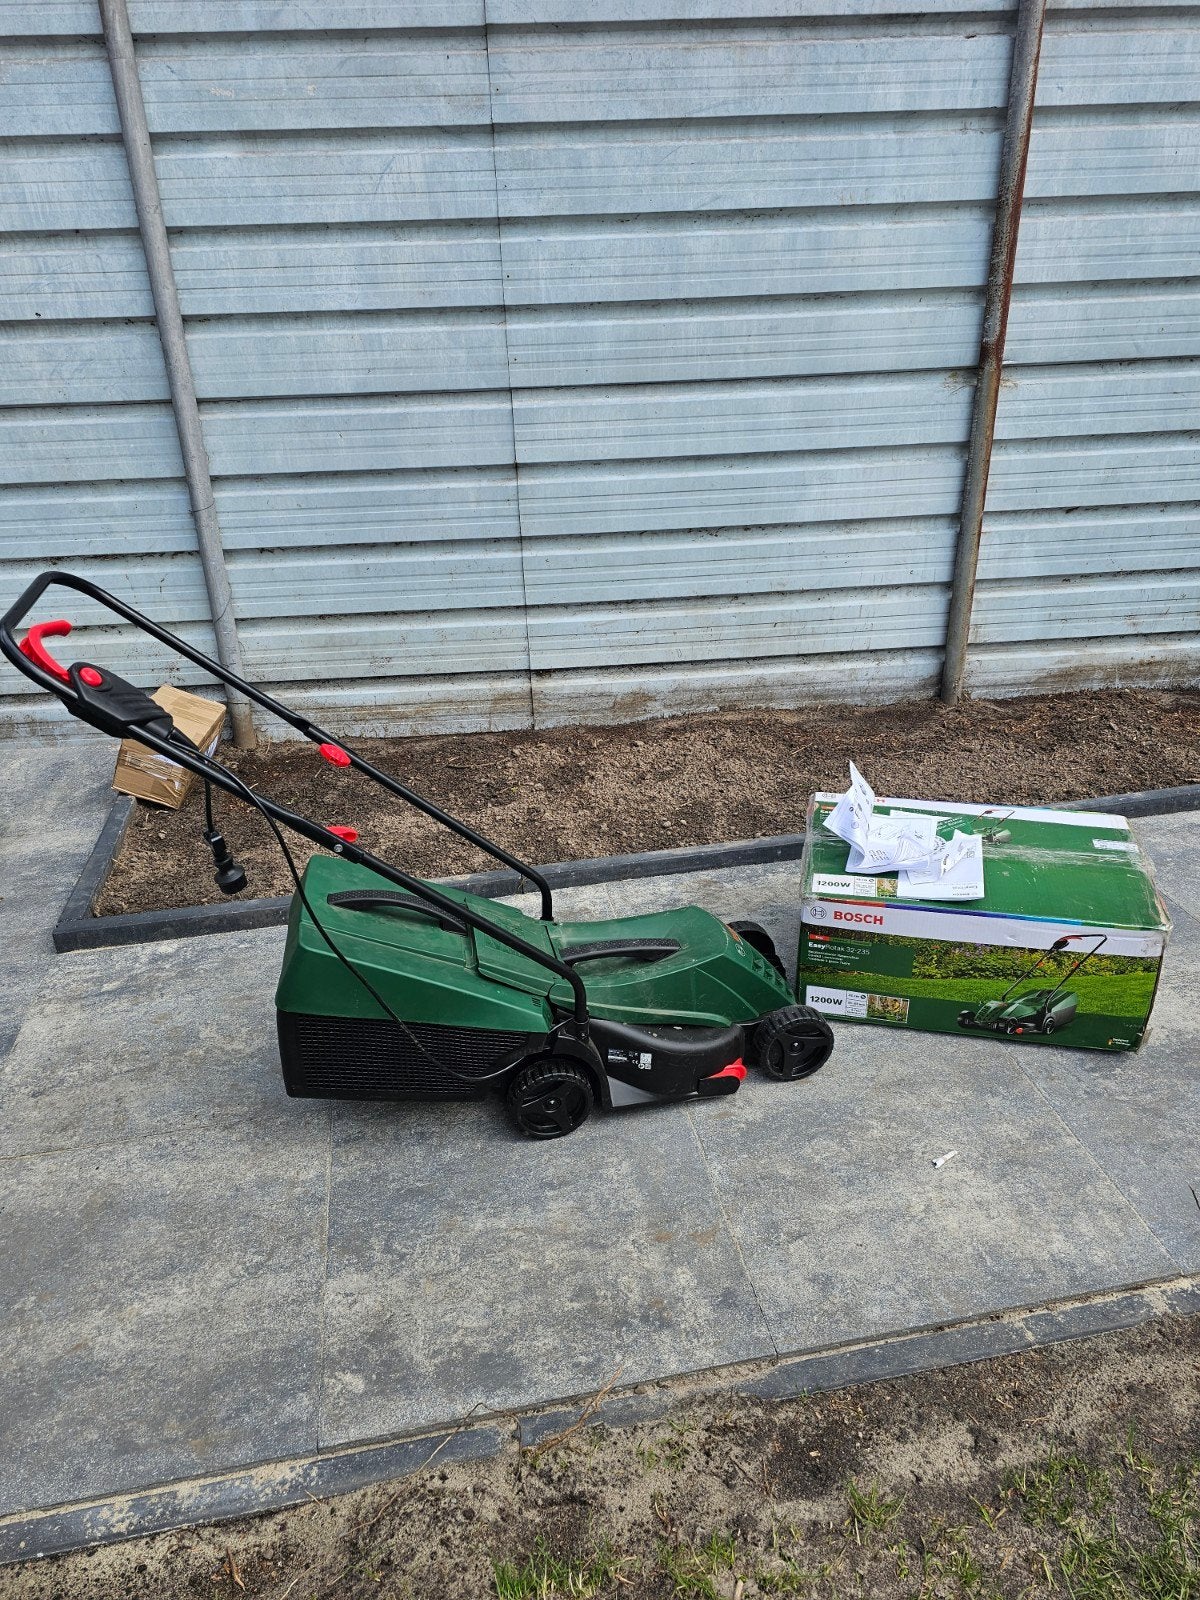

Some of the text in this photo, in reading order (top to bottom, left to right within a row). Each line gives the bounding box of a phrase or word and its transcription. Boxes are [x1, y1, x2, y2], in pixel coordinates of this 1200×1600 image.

[817, 880, 851, 888] 1200W
[833, 910, 884, 926] BOSCH
[809, 995, 843, 1006] 1200W
